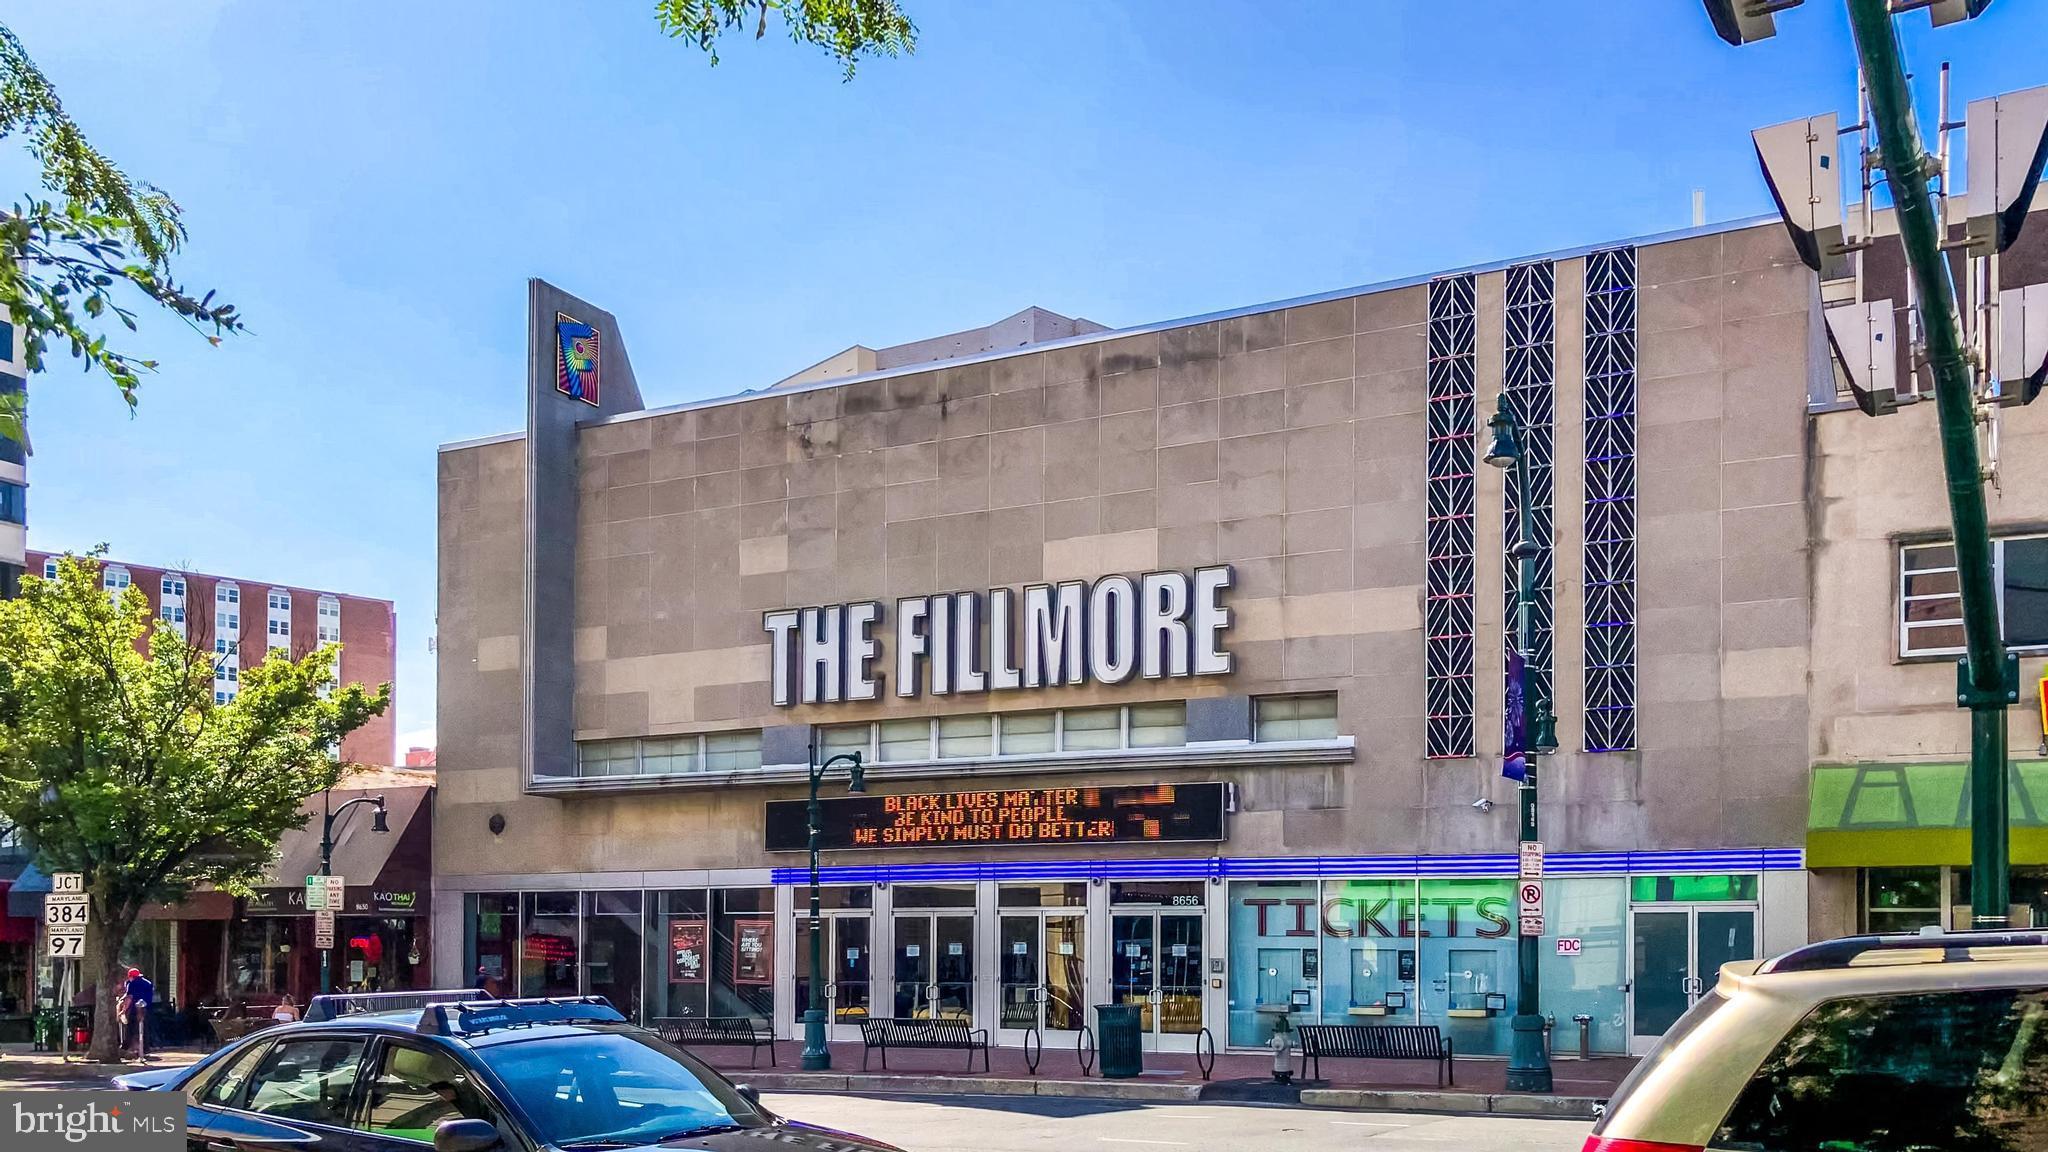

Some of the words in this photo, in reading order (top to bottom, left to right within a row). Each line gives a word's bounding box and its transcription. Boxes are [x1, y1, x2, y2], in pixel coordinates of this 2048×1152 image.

[762, 600, 885, 707] THE
[895, 564, 1237, 698] FILLMORE
[884, 794, 940, 812] BLACK
[946, 792, 998, 809] LIVES
[920, 809, 964, 826] KIND
[970, 808, 994, 824] TO
[998, 806, 1068, 823] PEOPLE
[854, 828, 878, 843] WE
[882, 826, 949, 843] SIMPLY
[954, 824, 1004, 840] MUST
[1008, 824, 1033, 839] DO
[56, 876, 80, 890] JCT
[288, 890, 306, 905] KA
[1172, 895, 1199, 906] 8656
[48, 906, 86, 922] 384
[1243, 896, 1512, 938] TICKETS
[52, 937, 82, 954] 97
[1558, 940, 1580, 951] FDC
